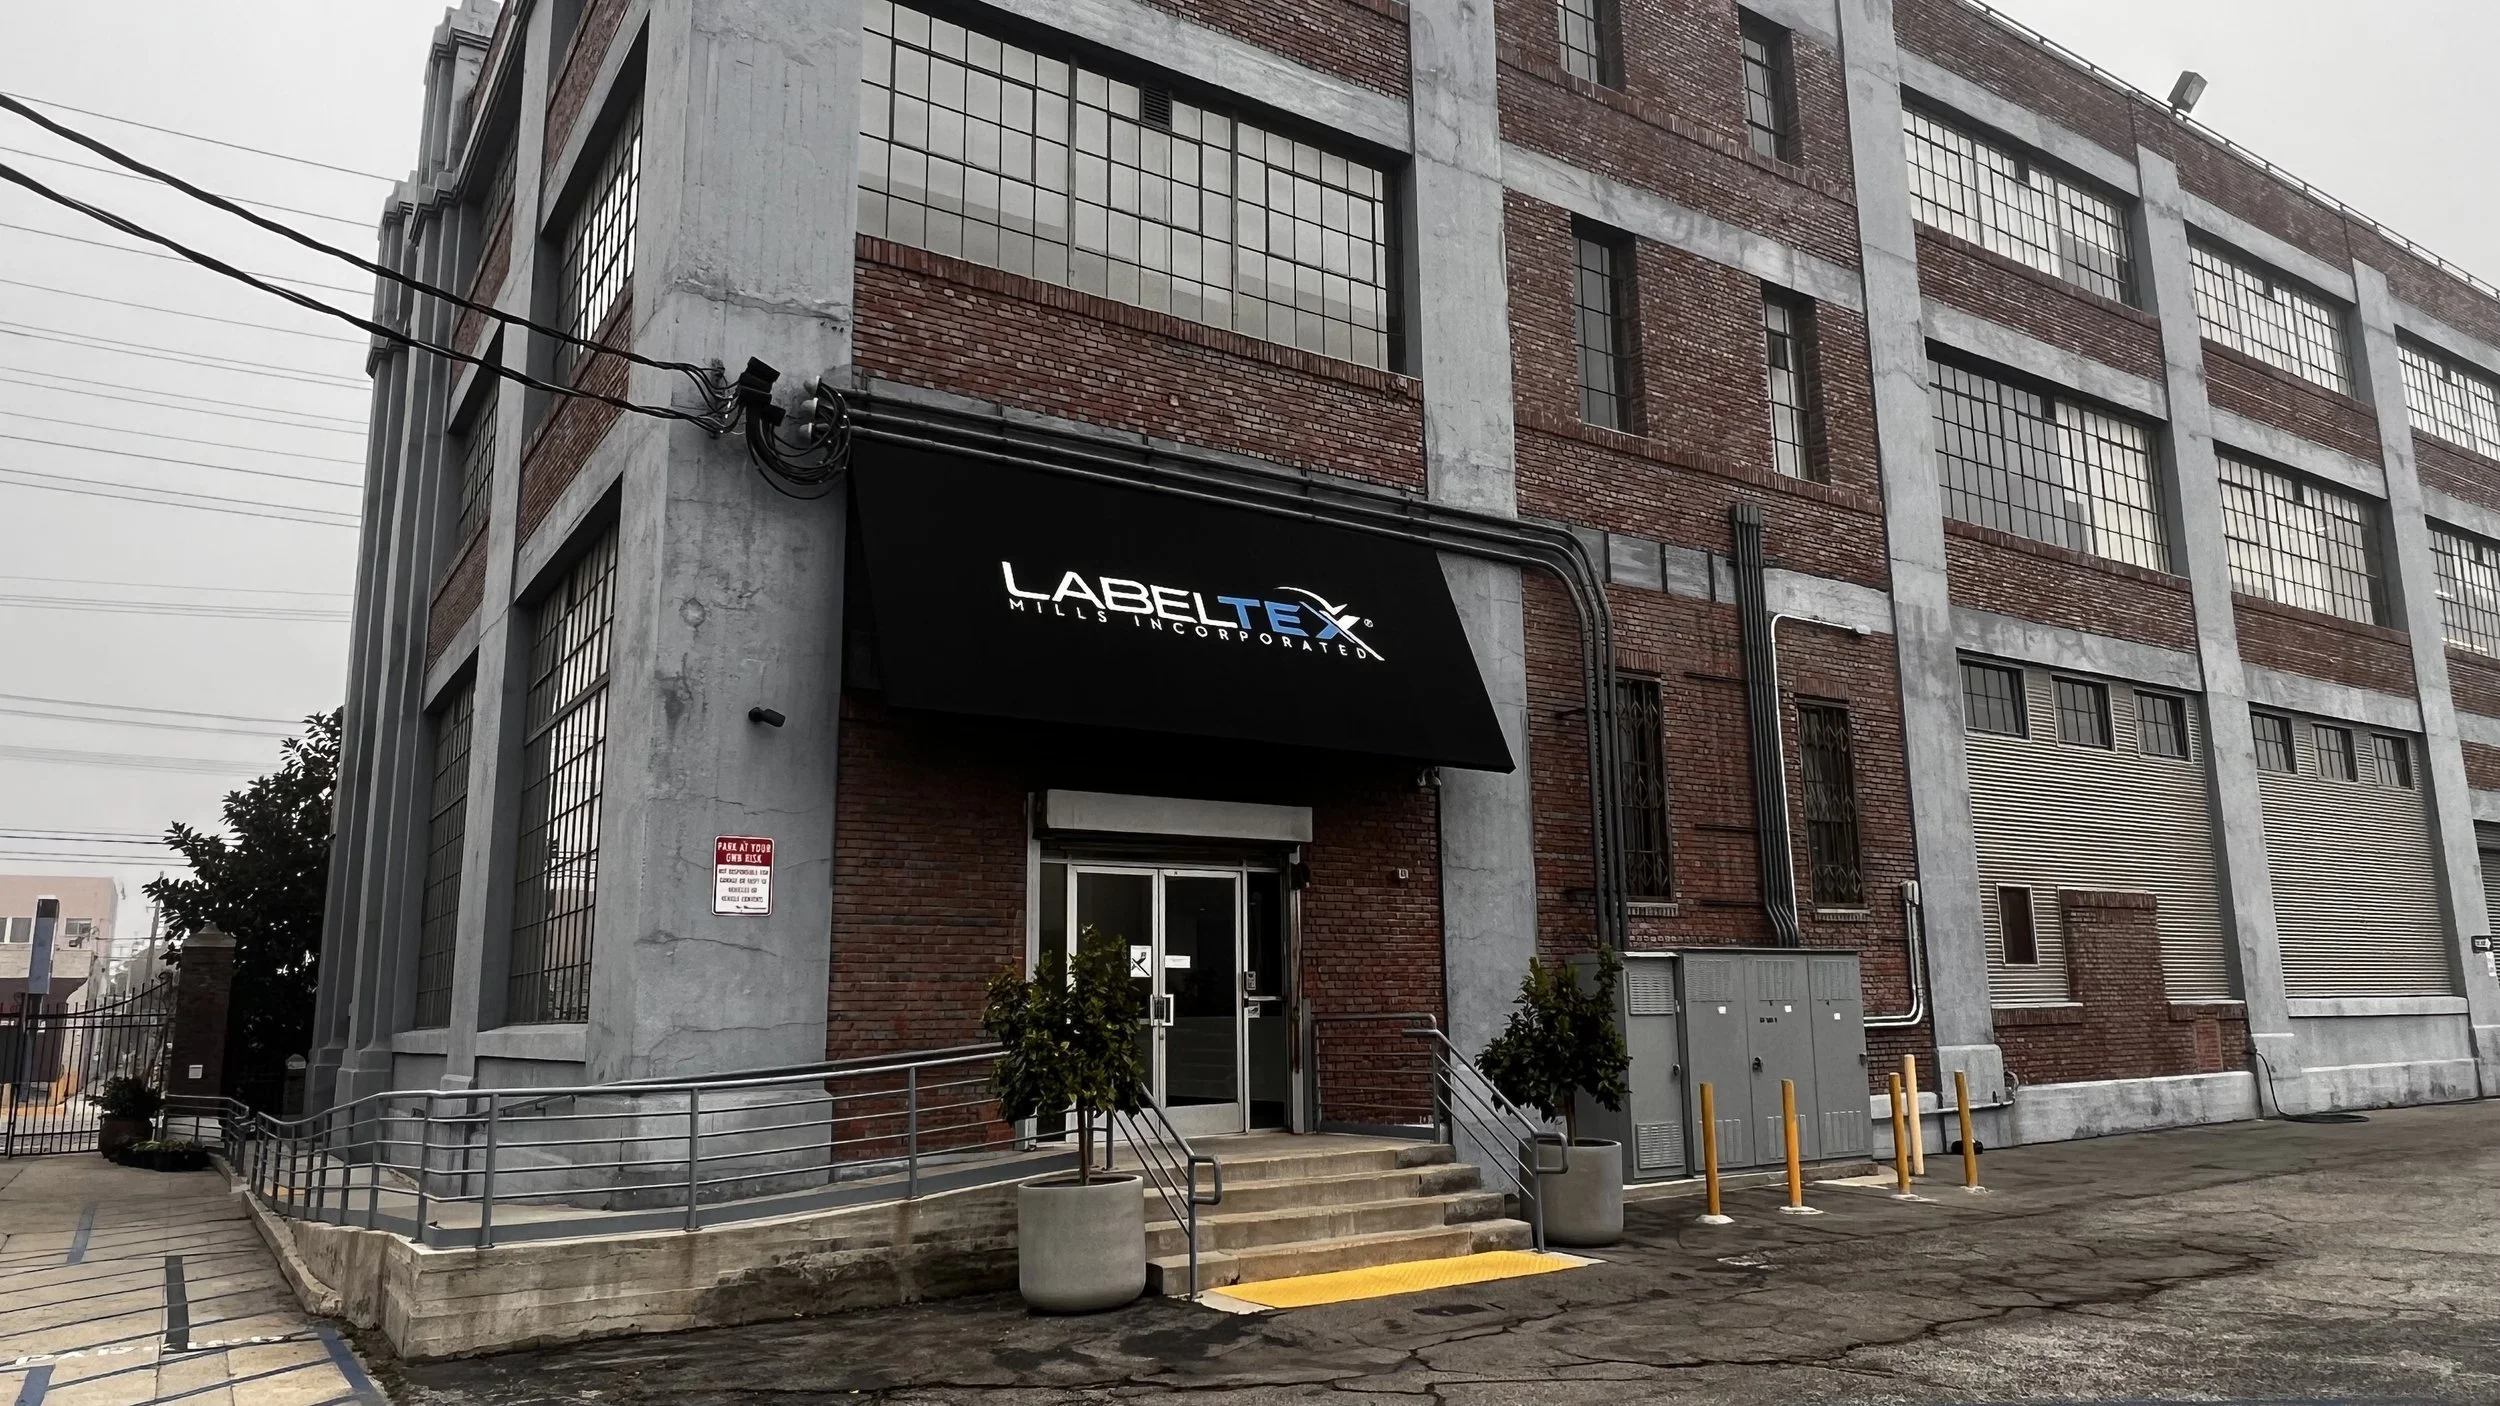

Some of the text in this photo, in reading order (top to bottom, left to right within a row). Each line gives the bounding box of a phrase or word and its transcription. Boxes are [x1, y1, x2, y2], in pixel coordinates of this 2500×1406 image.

[1010, 598, 1367, 660] MILLS INCORPORATED
[718, 842, 771, 853] PARK AT YOUR
[726, 853, 762, 863] OWN RISK
